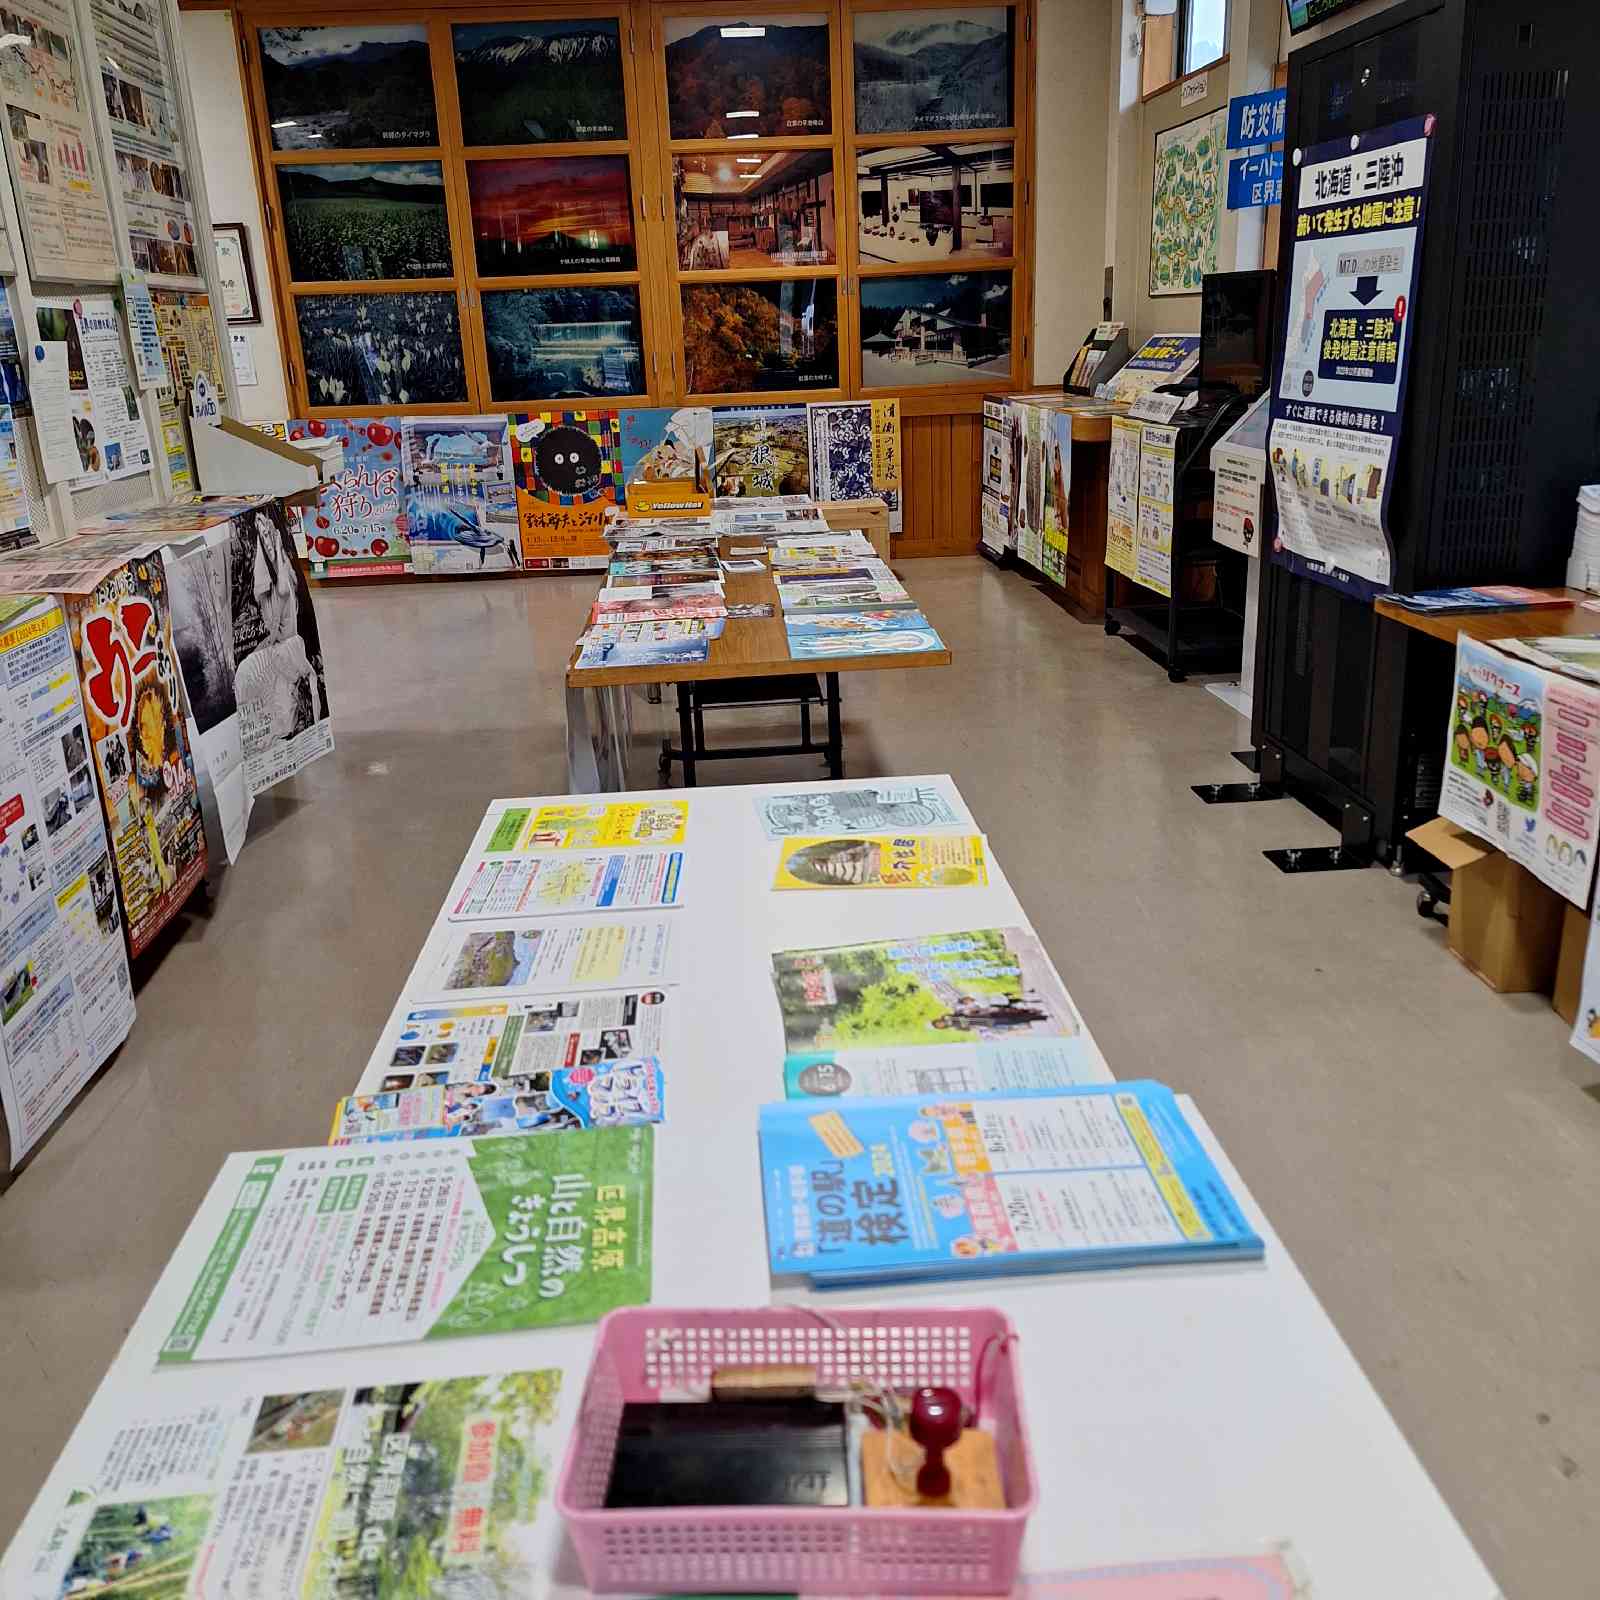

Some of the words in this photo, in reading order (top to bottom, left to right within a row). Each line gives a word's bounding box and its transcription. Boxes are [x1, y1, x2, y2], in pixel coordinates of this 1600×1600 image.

[1240, 98, 1286, 139] 防災情
[1240, 153, 1283, 181] イーハト
[1314, 151, 1404, 199] 北海道・三陸沖
[1329, 317, 1394, 339] 北海道・三陸沖
[1322, 339, 1397, 363] 後発地震注意情報
[752, 444, 774, 490] 根城
[331, 491, 373, 522] 狩り
[851, 1179, 909, 1245] 検定
[502, 1192, 546, 1287] きょうしつ
[538, 1173, 593, 1299] 山と自然の
